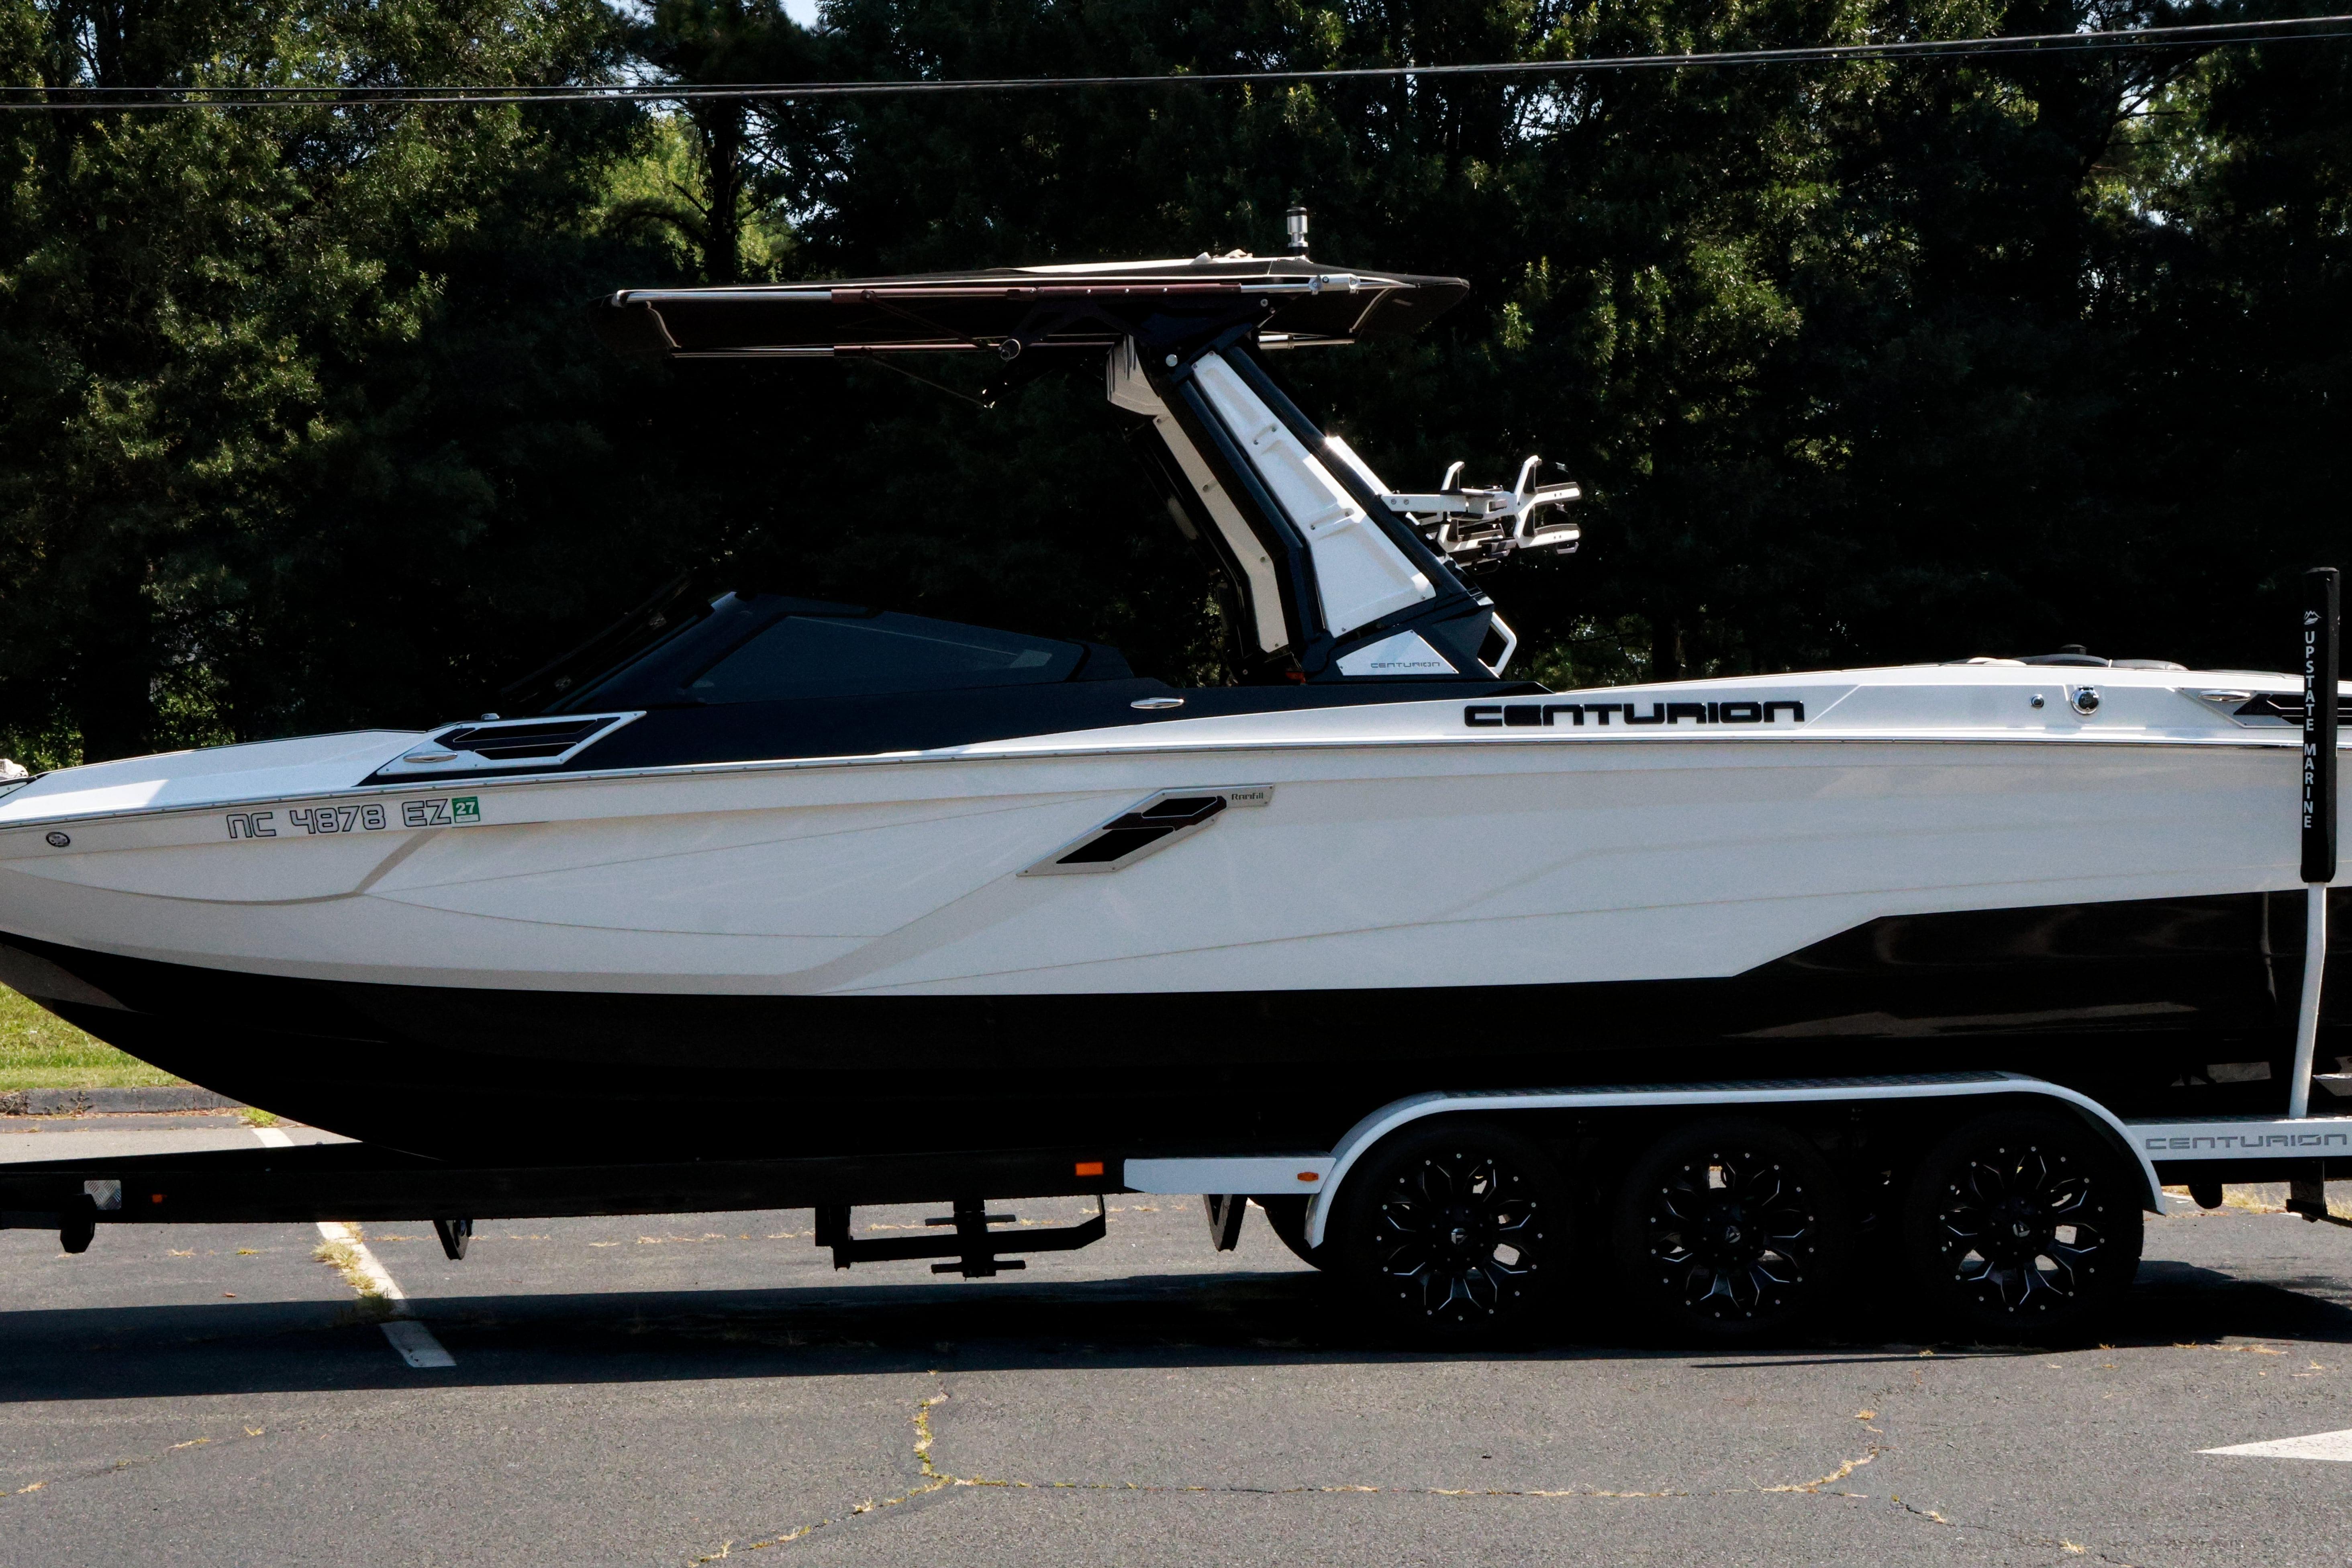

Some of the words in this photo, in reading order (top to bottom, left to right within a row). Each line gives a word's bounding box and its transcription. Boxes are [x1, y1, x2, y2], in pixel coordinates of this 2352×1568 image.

[2305, 631, 2315, 731] UPSTATE
[1464, 700, 1805, 727] CENTURION
[2303, 743, 2316, 828] MARINE
[227, 812, 276, 838] NC
[290, 804, 386, 834] 4878
[402, 798, 451, 827] EZ
[456, 801, 476, 815] 27
[2146, 1134, 2347, 1149] CENTURION
